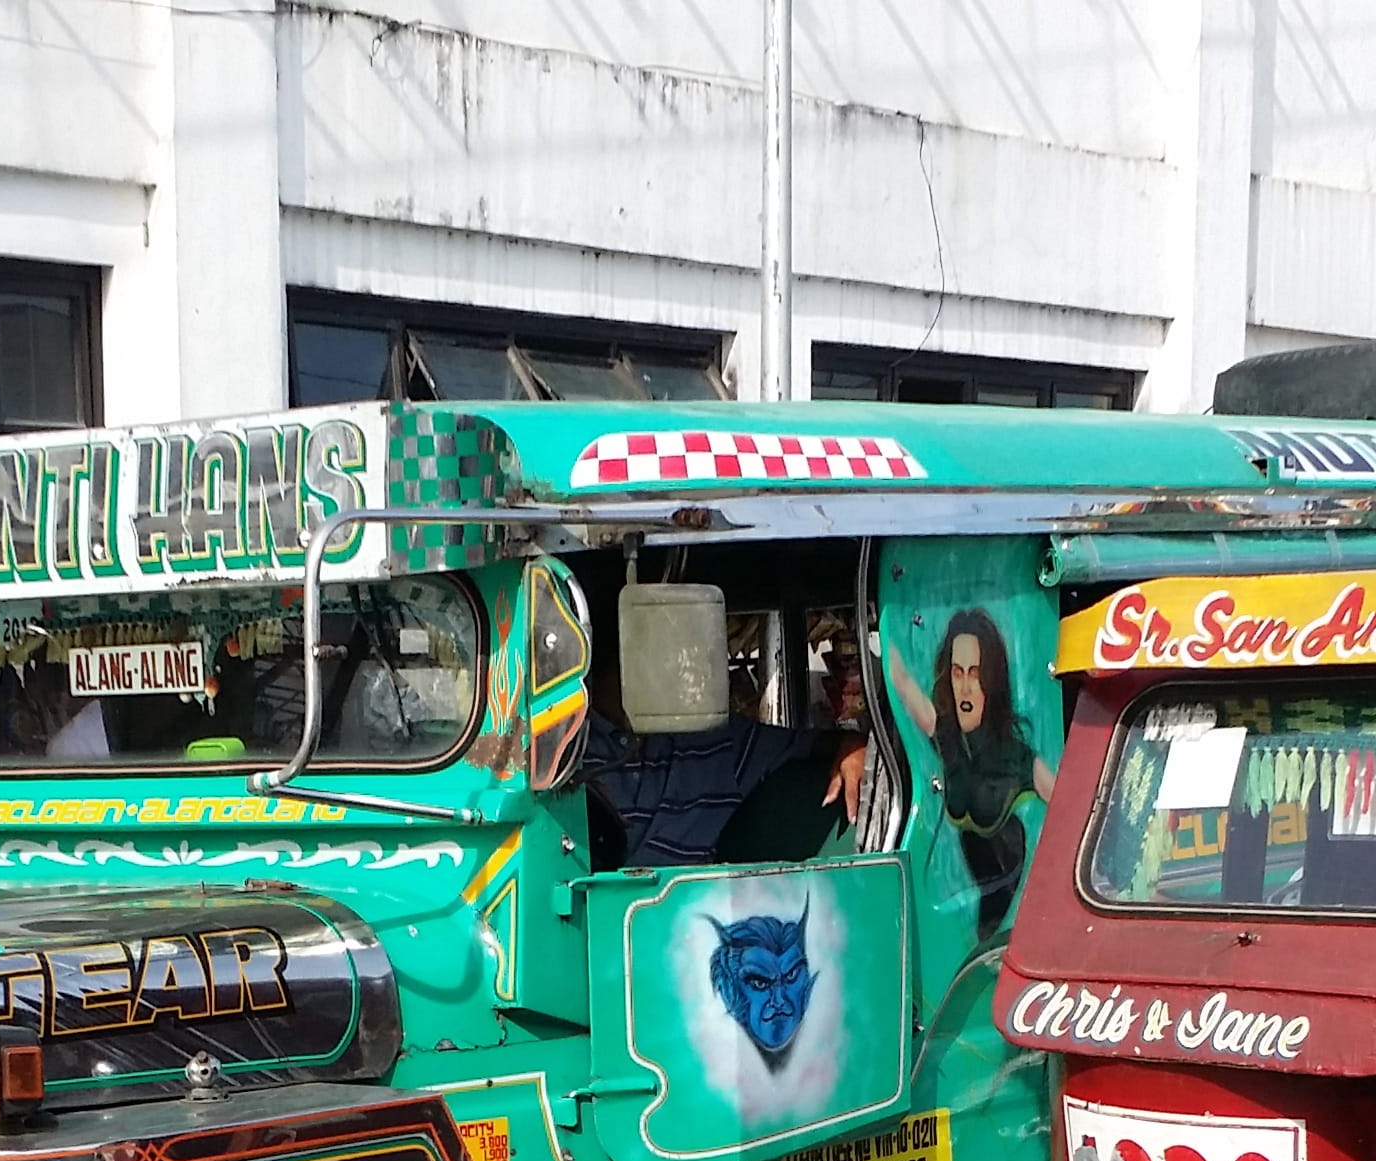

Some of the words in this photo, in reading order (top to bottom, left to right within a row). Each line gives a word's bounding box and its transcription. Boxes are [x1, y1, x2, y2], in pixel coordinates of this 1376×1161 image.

[129, 419, 366, 574] HANS
[1181, 590, 1298, 667] San
[1010, 981, 1140, 1043] Chris
[1142, 999, 1172, 1041] &
[1177, 992, 1310, 1058] Jane
